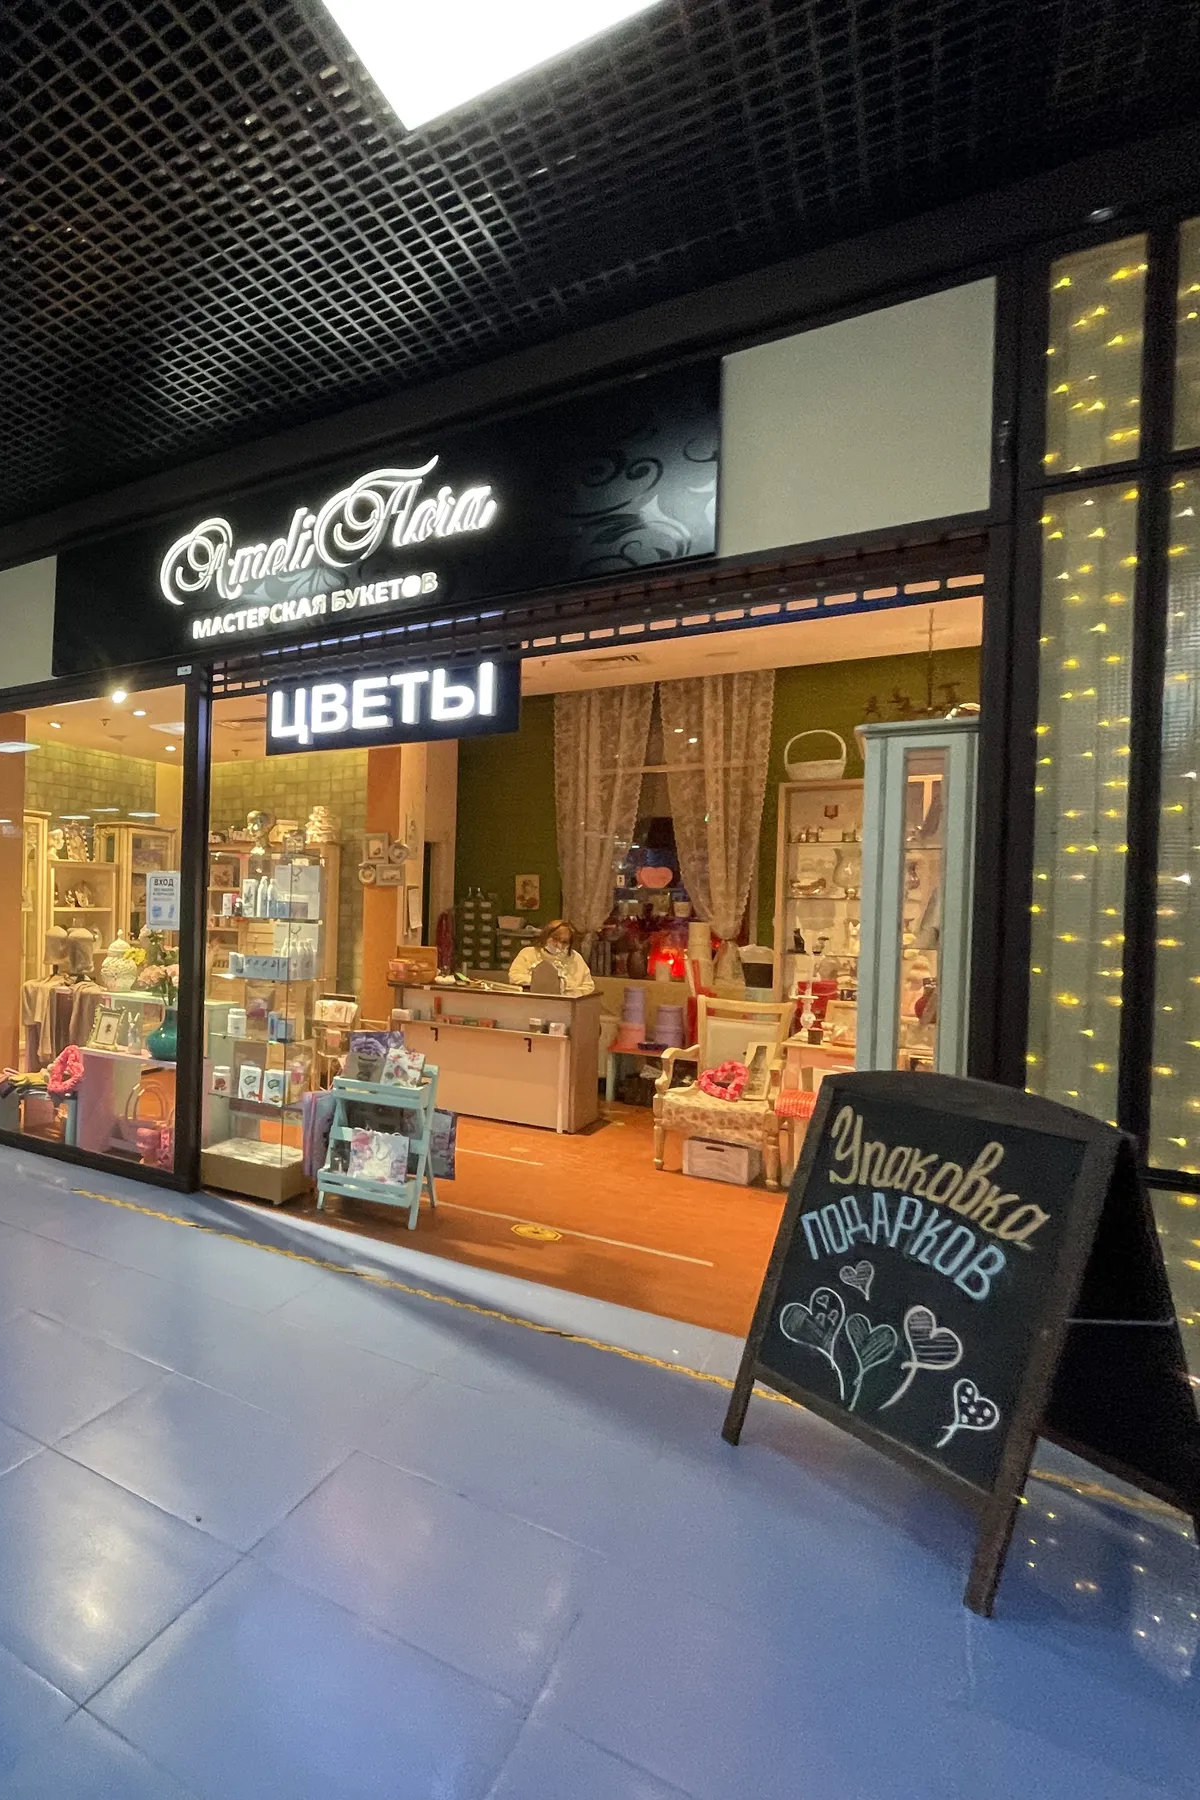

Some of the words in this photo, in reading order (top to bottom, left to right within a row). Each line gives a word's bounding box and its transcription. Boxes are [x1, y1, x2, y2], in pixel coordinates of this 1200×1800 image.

[192, 593, 327, 640] МАСТЕРСКАЯ
[331, 571, 439, 613] БУКЕТОВ
[271, 661, 497, 746] ЦВЕТЫ
[154, 878, 174, 887] ВХОД
[829, 1105, 1051, 1251] Упаковка
[801, 1192, 1007, 1301] ПОДАРКОВ
